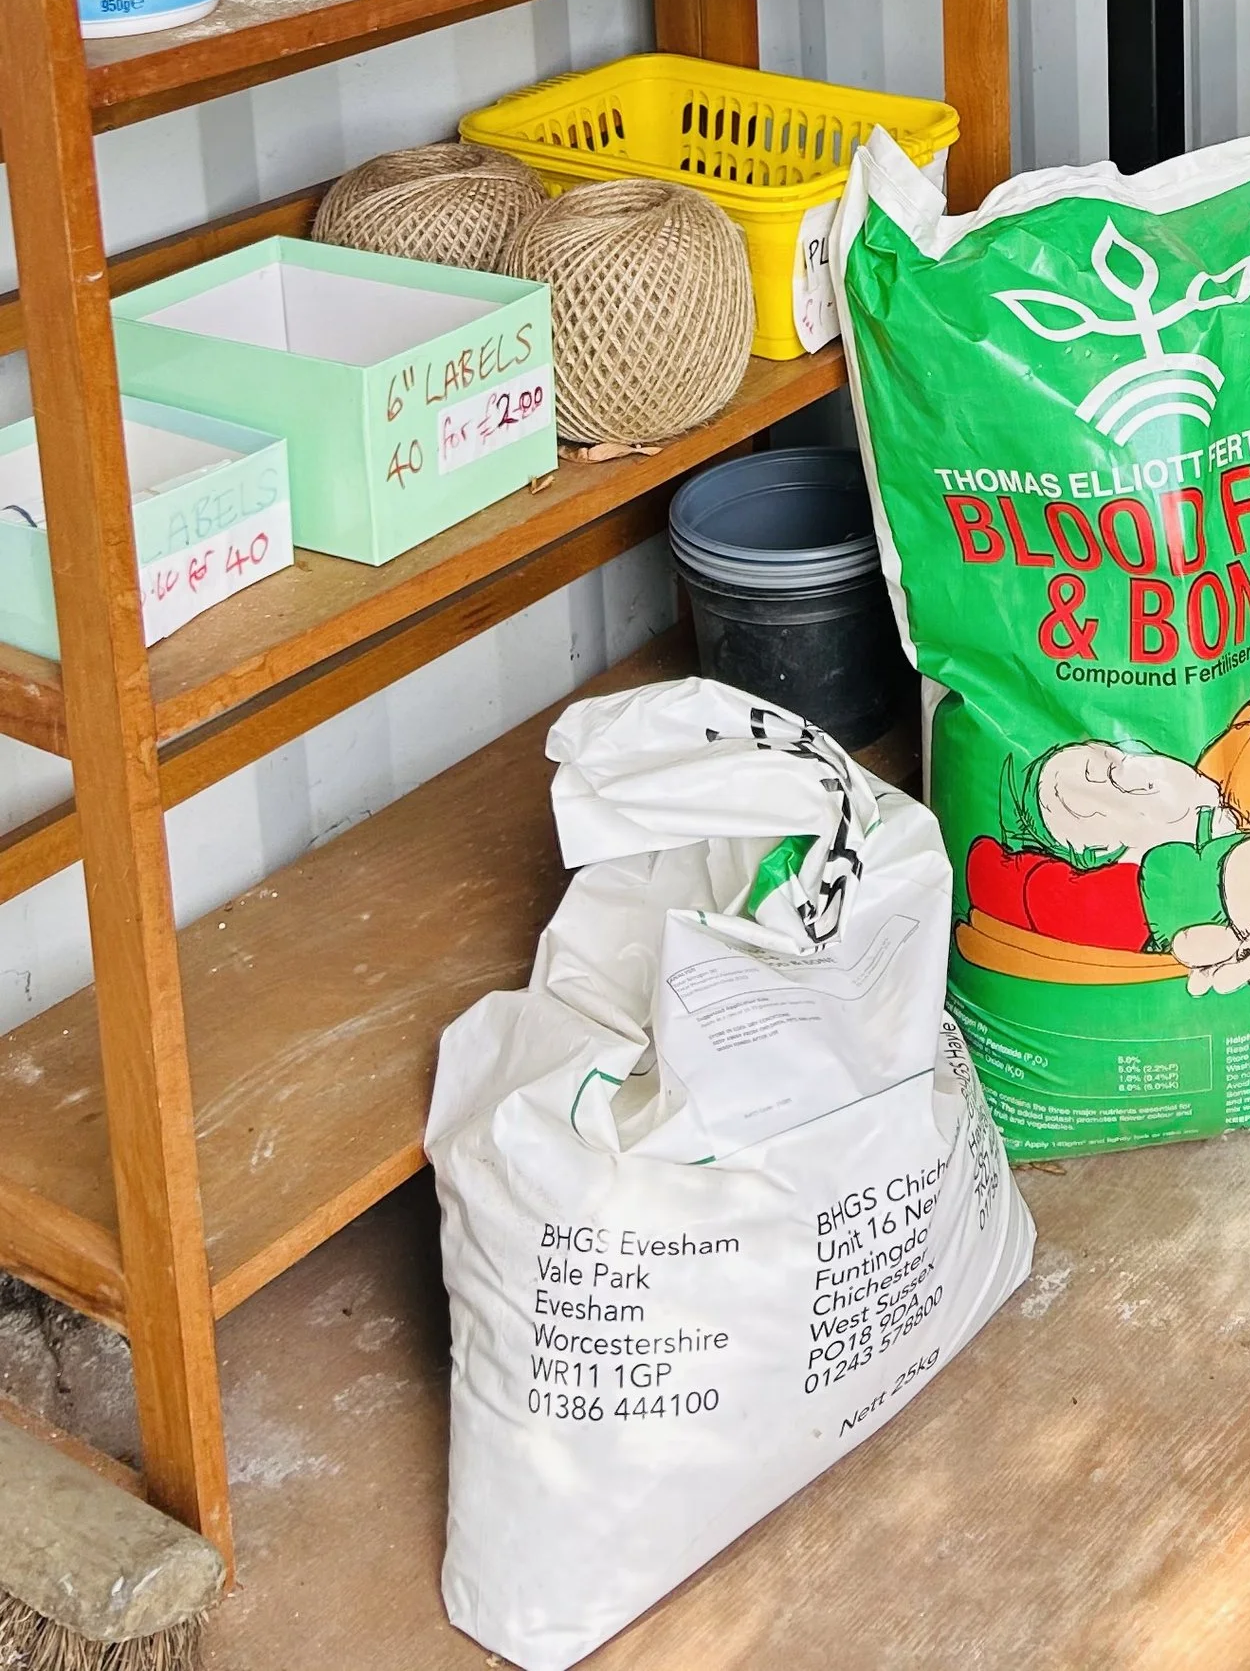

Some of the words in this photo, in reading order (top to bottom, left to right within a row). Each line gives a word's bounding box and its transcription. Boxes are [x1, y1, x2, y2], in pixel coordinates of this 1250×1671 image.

[425, 322, 533, 406] LABELS
[386, 438, 424, 490] 40
[442, 415, 471, 461] for
[933, 467, 1064, 500] THOMAS
[1067, 449, 1204, 499] ELLIOTT
[943, 486, 1208, 578] BLOOD
[225, 531, 269, 576] 40
[1037, 572, 1100, 662] &
[1056, 660, 1178, 689] Compound
[1226, 1044, 1250, 1055] Read
[1226, 1053, 1250, 1064] Store
[1226, 1073, 1240, 1083] Do
[1226, 1078, 1250, 1090] Avoid
[1000, 1092, 1032, 1109] contains
[1033, 1103, 1047, 1114] the
[1048, 1105, 1071, 1116] three
[1073, 1107, 1097, 1117] major
[1099, 1106, 1138, 1116] nutrients
[1001, 1100, 1017, 1114] The
[1017, 1107, 1044, 1121] added
[1045, 1112, 1075, 1123] potash
[1076, 1115, 1118, 1124] promotes
[1175, 1108, 1193, 1117] and
[1009, 1113, 1026, 1126] and
[1226, 1096, 1243, 1108] and
[1025, 1138, 1049, 1150] Apply
[817, 1186, 879, 1237] BHGS
[540, 1222, 612, 1255] BHGS
[620, 1230, 741, 1256] Evesham
[816, 1228, 864, 1264] Unit
[867, 1211, 898, 1240] 16
[536, 1254, 584, 1287] Vale
[593, 1262, 652, 1290] Park
[812, 1246, 929, 1317] Chichester
[534, 1288, 646, 1323] Evesham
[809, 1305, 871, 1343] West
[875, 1256, 936, 1316] Sussex
[532, 1321, 730, 1356] Worcestershire
[803, 1344, 874, 1395] 01243
[878, 1283, 944, 1355] 578800
[807, 1324, 873, 1371] PO18
[879, 1292, 920, 1335] 9DA
[530, 1353, 601, 1389] WR11
[613, 1362, 673, 1389] 1GP
[527, 1387, 605, 1423] 01386
[613, 1387, 721, 1422] 444100
[838, 1390, 889, 1439] Nett
[890, 1346, 941, 1398] 25kg
